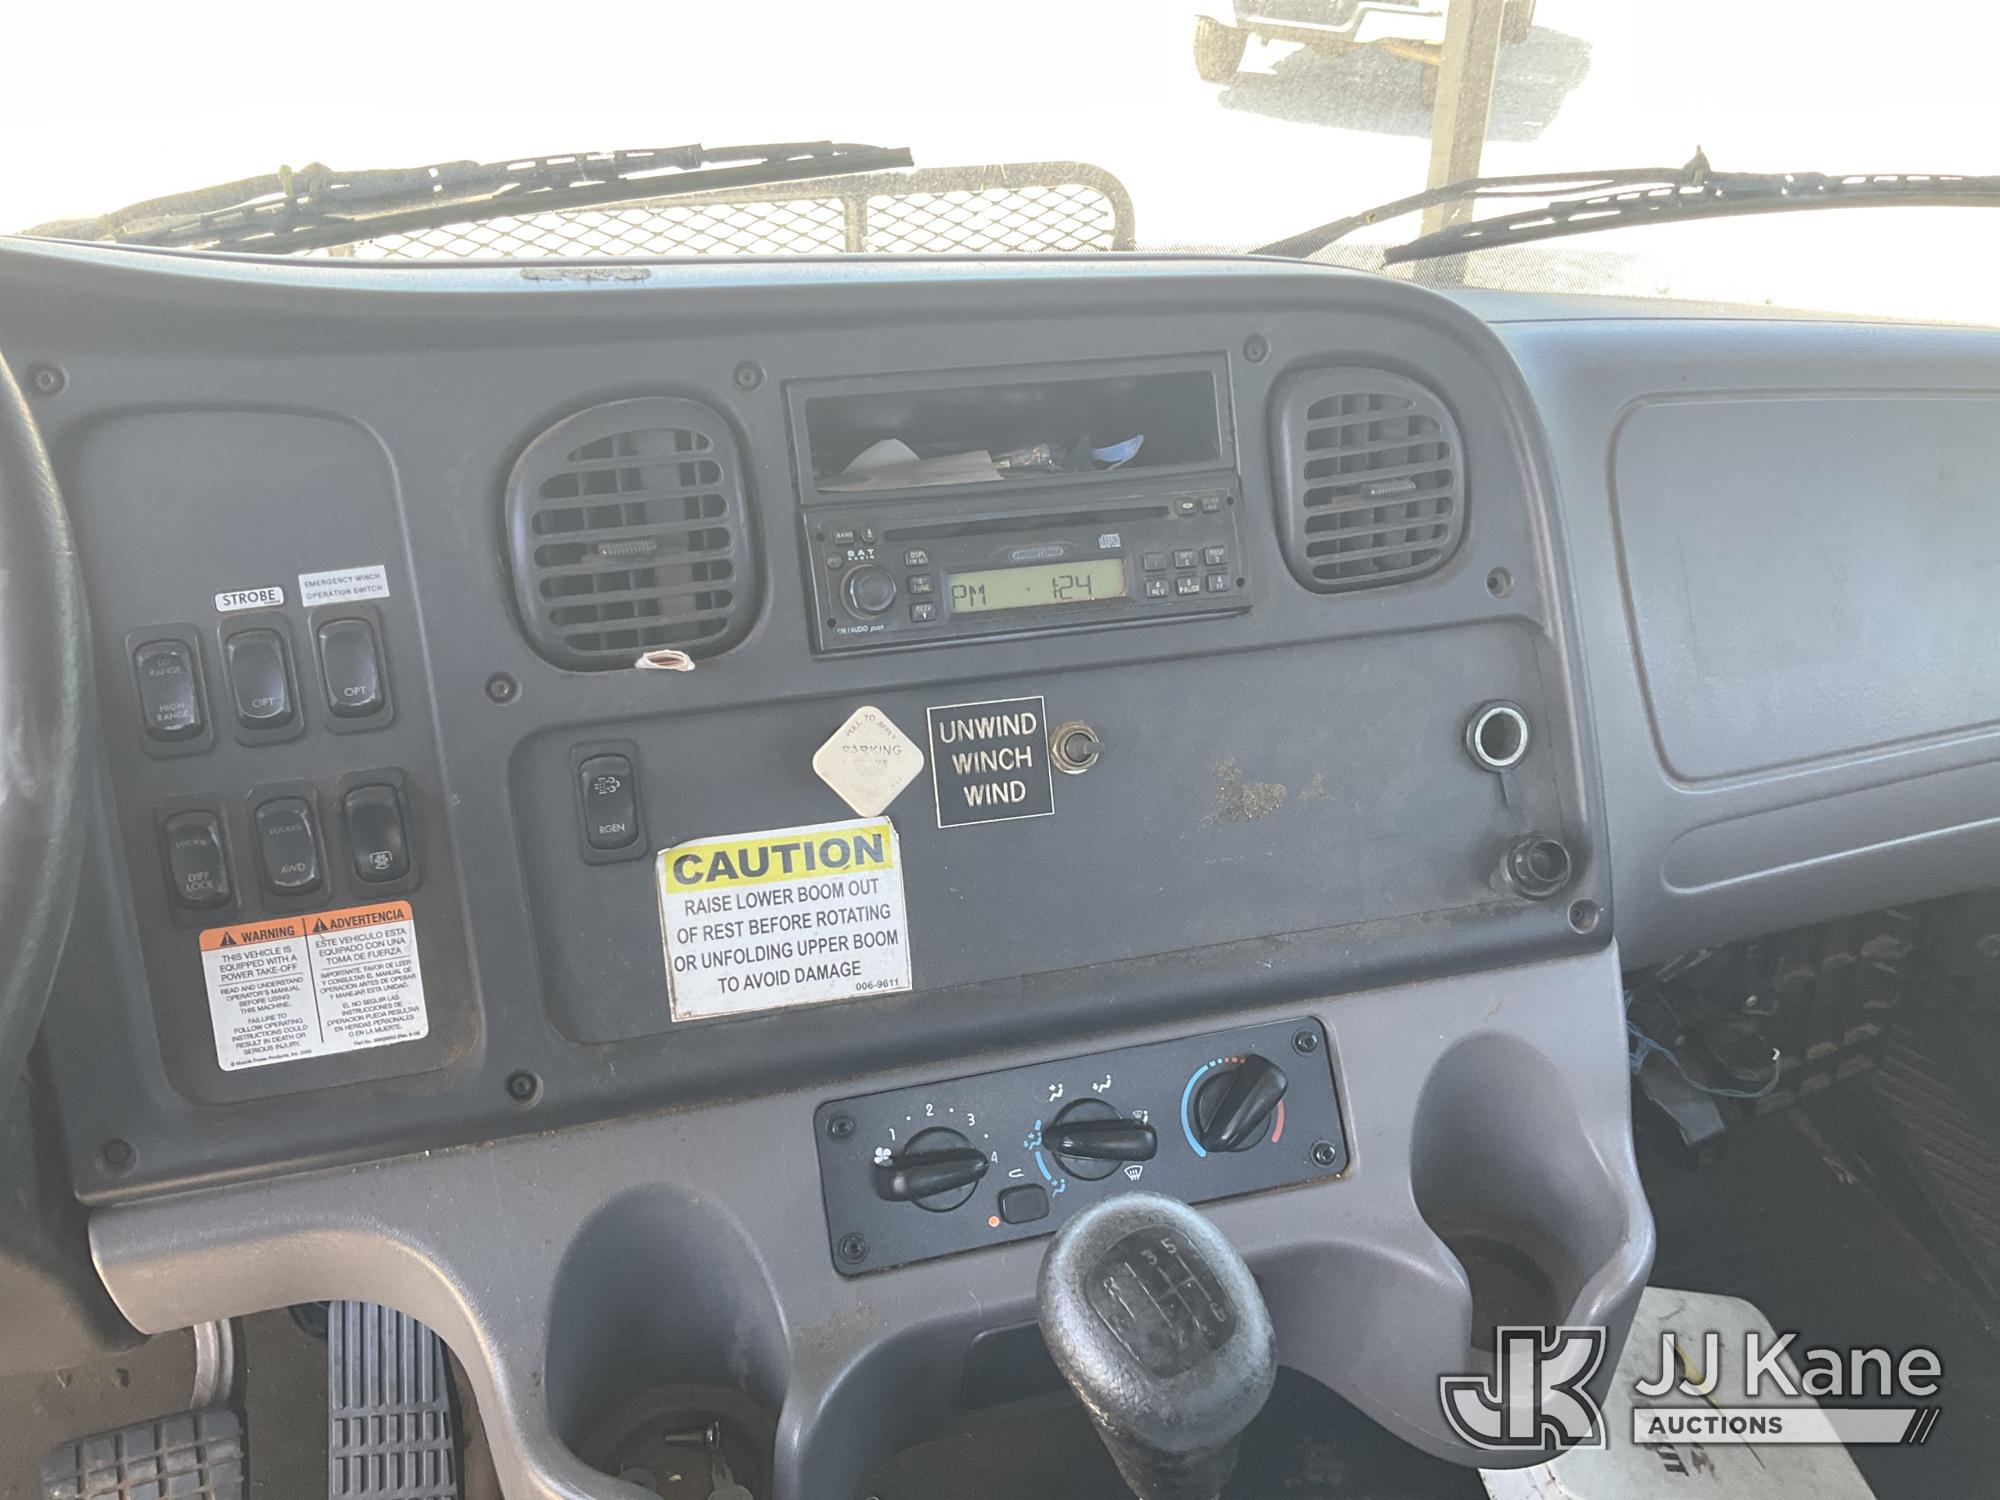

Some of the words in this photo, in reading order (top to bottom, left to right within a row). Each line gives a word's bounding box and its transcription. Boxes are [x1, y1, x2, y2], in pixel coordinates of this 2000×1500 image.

[304, 575, 354, 588] EMERGENCY
[354, 573, 381, 582] WINCH
[222, 589, 276, 607] STROBE
[306, 588, 352, 600] OPERATION
[353, 585, 384, 595] SWITCH
[951, 584, 986, 609] PM
[344, 686, 366, 697] OPT
[159, 702, 185, 713] HIGH
[252, 697, 276, 709] OPT
[157, 711, 188, 721] RANGE
[940, 712, 1037, 743] UNWIND
[952, 746, 1033, 775] WINCH
[963, 780, 1026, 807] WIND
[599, 823, 625, 834] RGEN
[673, 833, 885, 885] CAUTION
[280, 863, 306, 874] AWD
[188, 871, 210, 883] DIFF
[186, 879, 214, 892] LOCK
[684, 895, 732, 916] RAISE
[737, 888, 793, 910] LOWER
[797, 882, 845, 903] BOOM
[849, 878, 879, 896] OUT
[330, 909, 405, 930] ADVERTENCIA
[677, 928, 699, 945] OF
[703, 921, 744, 941] REST
[749, 913, 812, 936] BEFORE
[816, 903, 892, 927] ROTATING
[241, 925, 295, 943] WARNING
[316, 938, 338, 948] ESTE
[339, 931, 383, 945] VEHICULO
[385, 928, 408, 938] ESTA
[222, 953, 241, 963] THIS
[244, 947, 281, 959] VEHICLE
[283, 945, 292, 953] IS
[319, 944, 363, 957] EQUIPADO
[365, 940, 385, 950] CON
[387, 937, 407, 946] UNA
[674, 955, 698, 972] OR
[701, 942, 793, 968] UNFOLDING
[797, 936, 849, 956] UPPER
[853, 929, 899, 950] BOOM
[326, 955, 352, 966] TOMA
[354, 952, 366, 961] DE
[367, 947, 402, 959] FUERZA
[220, 960, 264, 973] EQUIPPED
[266, 956, 286, 966] WITH
[363, 963, 384, 972] FAVOR
[395, 959, 412, 967] LEER
[221, 970, 254, 982] POWER
[256, 963, 298, 977] TAKE-OFF
[328, 973, 366, 985] CONSULTAR
[375, 968, 402, 978] MANUAL
[717, 976, 740, 994] TO
[743, 969, 791, 991] AVOID
[794, 961, 862, 983] DAMAGE
[221, 987, 240, 995] READ
[241, 984, 256, 992] AND
[257, 977, 304, 988] UNDERSTAND
[359, 979, 380, 988] ANTES
[390, 973, 417, 983] OPERAR
[855, 978, 900, 992] 006-9611
[226, 989, 270, 1001] OPERATOR'S
[335, 988, 366, 999] MANEJAR
[366, 985, 383, 994] ESTA
[239, 998, 267, 1007] BEFORE
[268, 994, 290, 1002] USING
[362, 996, 386, 1006] SEGUIR
[240, 1006, 256, 1014] THIS
[342, 1003, 393, 1017] INSTRUCCIONES
[365, 1011, 387, 1020] PUEDA
[388, 1006, 420, 1018] RESULTAR
[233, 1024, 263, 1035] FOLLOW
[264, 1018, 304, 1030] OPERATING
[248, 1015, 276, 1024] FAILURE
[232, 1029, 282, 1042] INSTRUCTIONS
[283, 1024, 308, 1034] COULD
[236, 1039, 262, 1049] RESULT
[272, 1033, 294, 1043] DEATH
[243, 1045, 274, 1056] SERIOUS
[925, 1103, 934, 1117] 2
[967, 1113, 975, 1127] 3
[889, 1128, 896, 1141] 1
[990, 1151, 998, 1164] 4
[1160, 1238, 1177, 1254] 5
